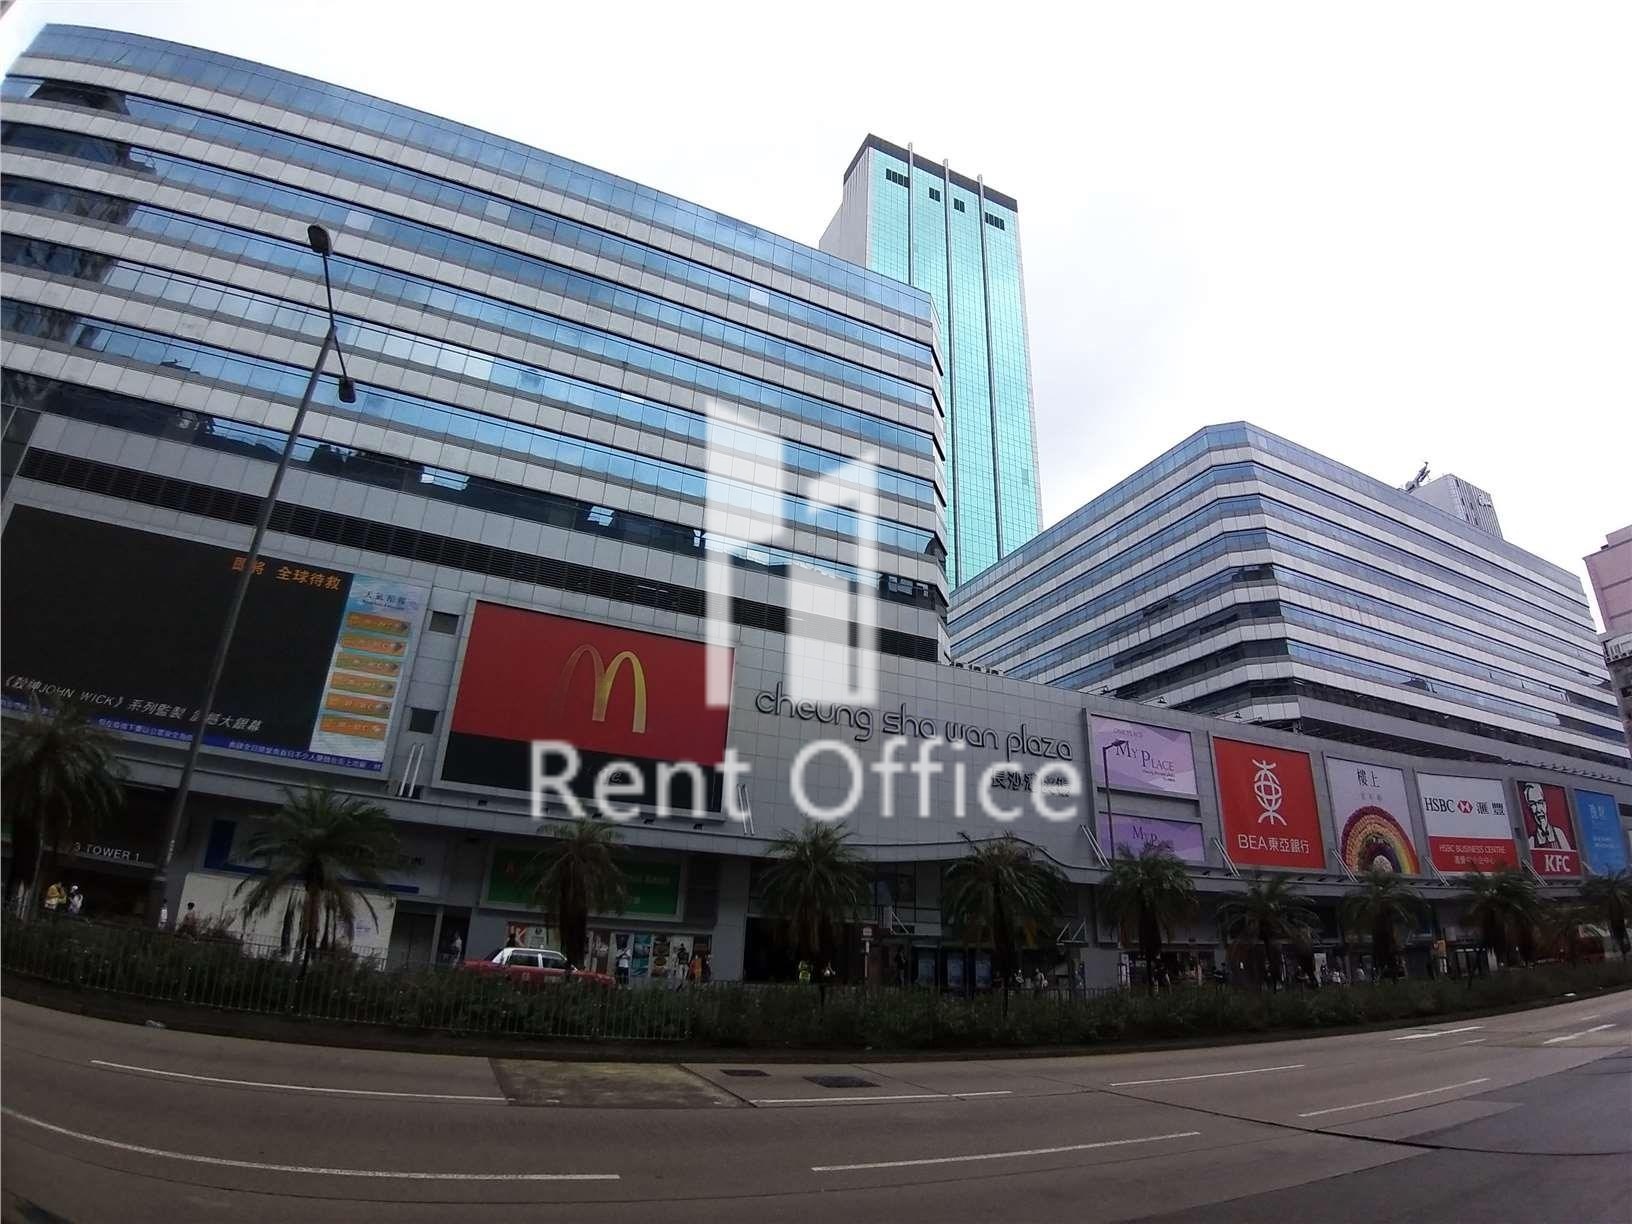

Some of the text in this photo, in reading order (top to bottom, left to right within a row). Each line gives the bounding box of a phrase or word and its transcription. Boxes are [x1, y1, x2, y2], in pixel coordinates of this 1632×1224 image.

[755, 682, 1073, 763] cheung sha wan plaza
[1424, 797, 1455, 813] HSBC
[87, 844, 130, 860] TOWER
[1238, 834, 1310, 854] BEA 東亞銀行
[1545, 855, 1571, 873] KFC
